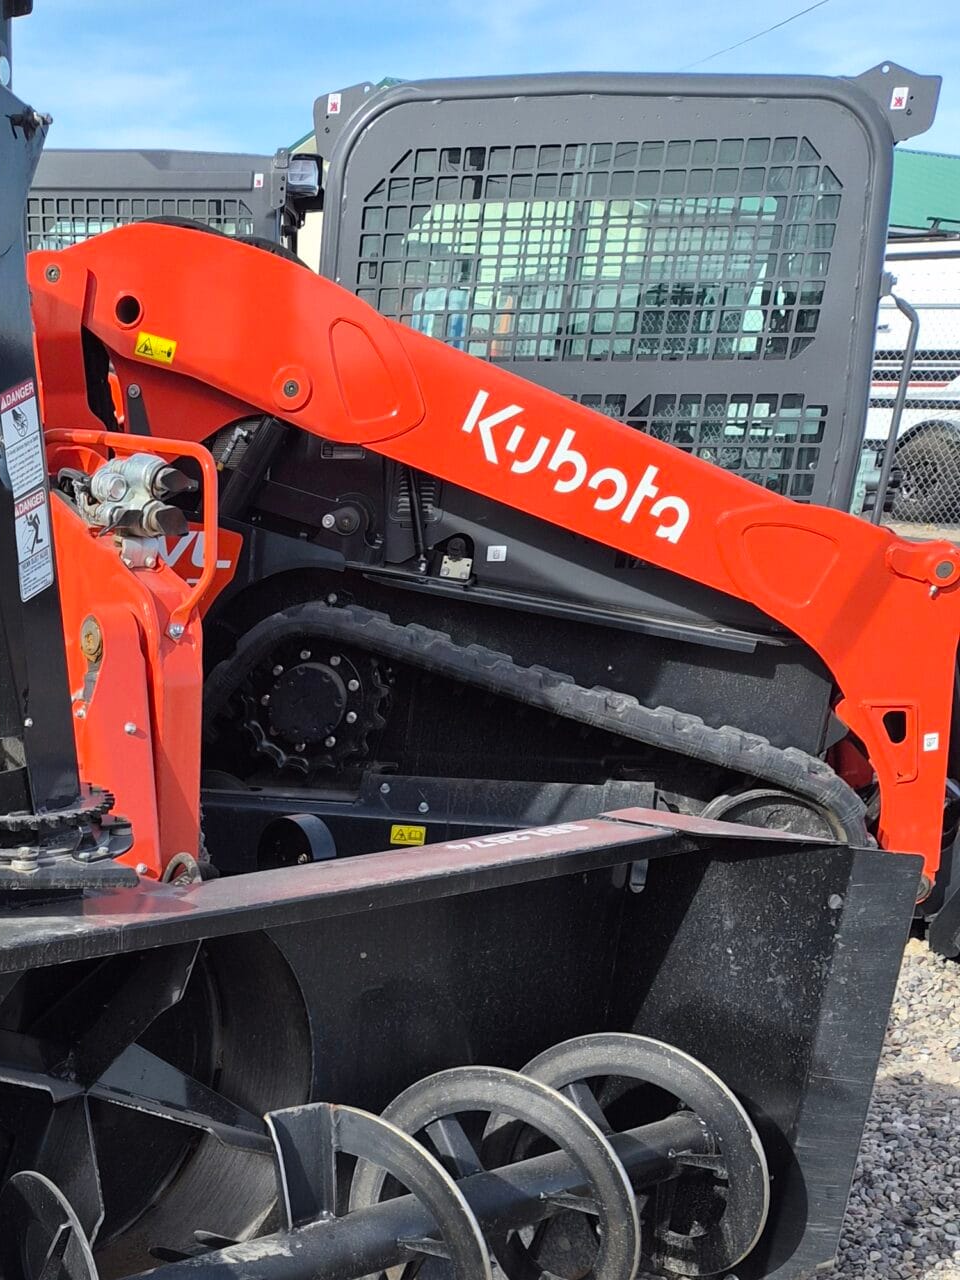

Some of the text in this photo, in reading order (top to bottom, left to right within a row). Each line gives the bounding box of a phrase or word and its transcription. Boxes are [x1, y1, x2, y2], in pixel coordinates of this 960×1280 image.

[6, 381, 35, 406] DANGER
[461, 389, 690, 545] Kubota
[19, 491, 45, 514] DANGER
